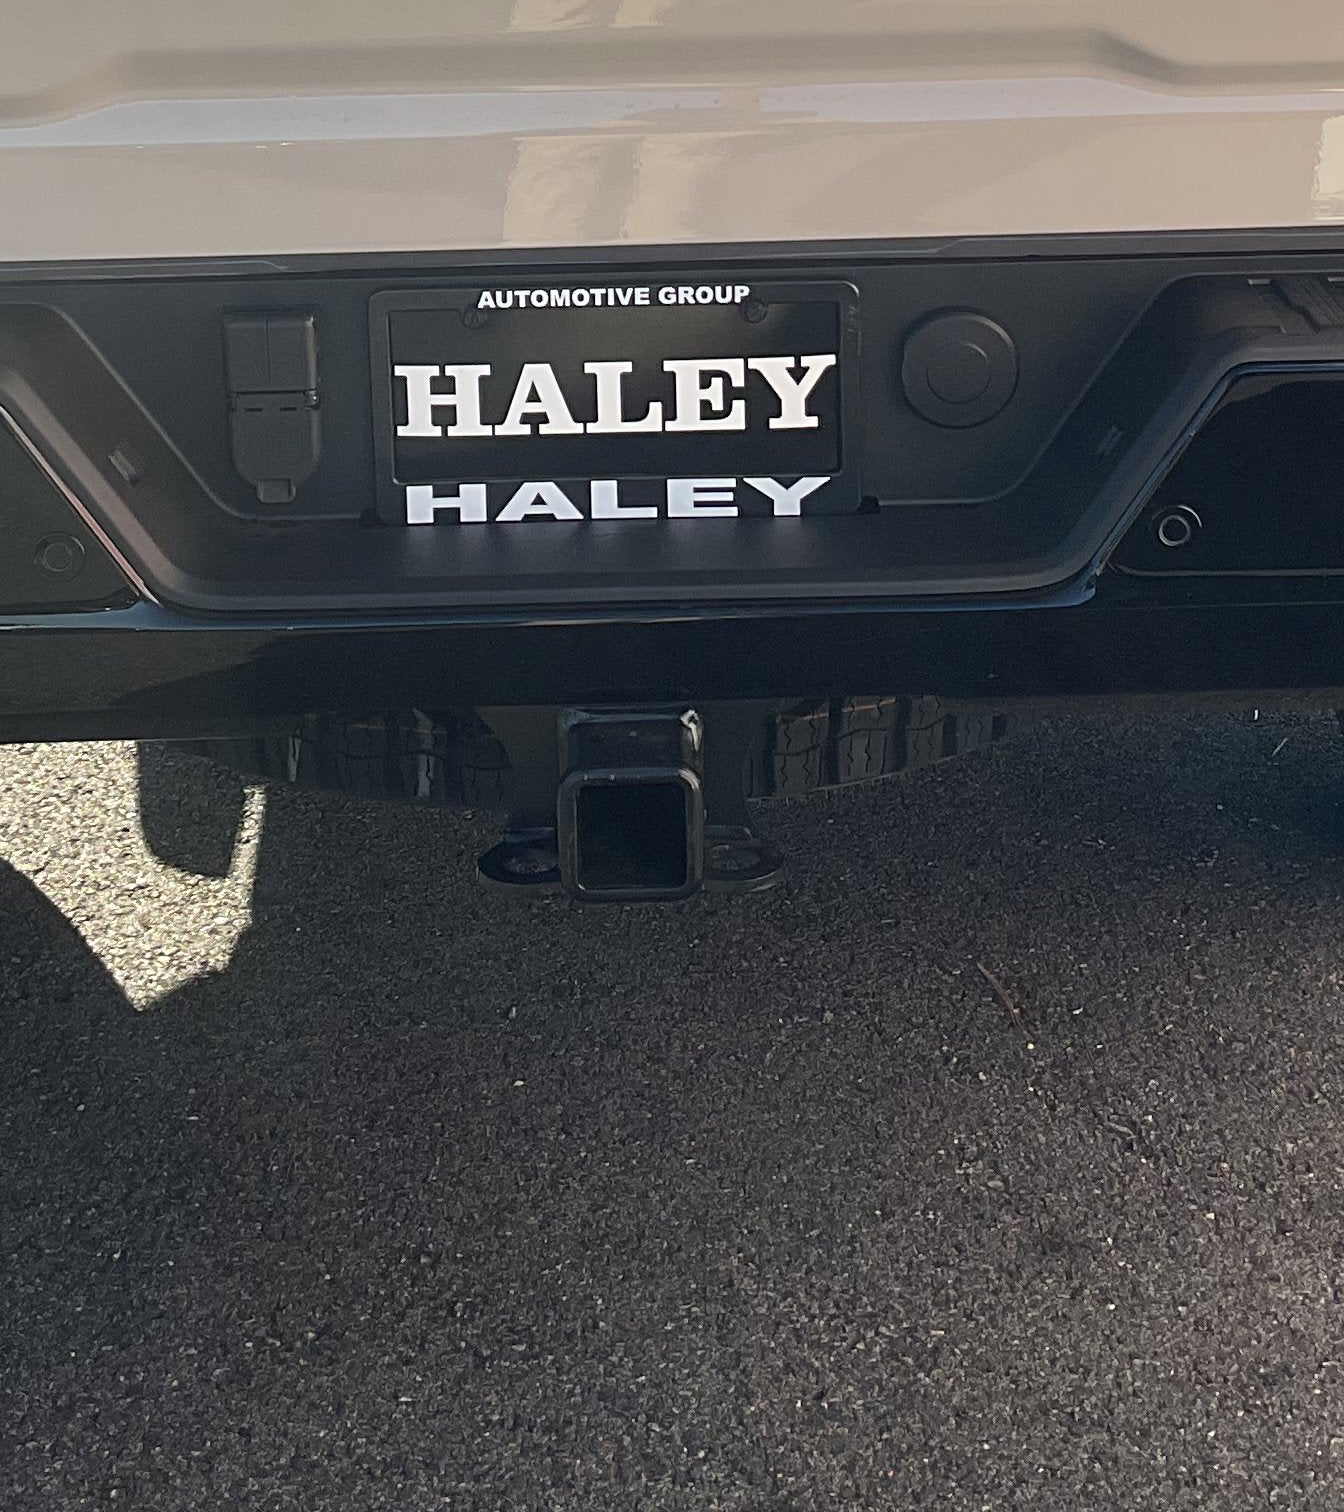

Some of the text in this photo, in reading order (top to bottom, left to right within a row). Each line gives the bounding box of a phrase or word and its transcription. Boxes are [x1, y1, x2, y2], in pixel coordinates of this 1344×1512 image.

[477, 285, 751, 309] AUTOMOTIVE GROUP
[394, 354, 837, 437] HALEY
[405, 476, 831, 524] HALEY
